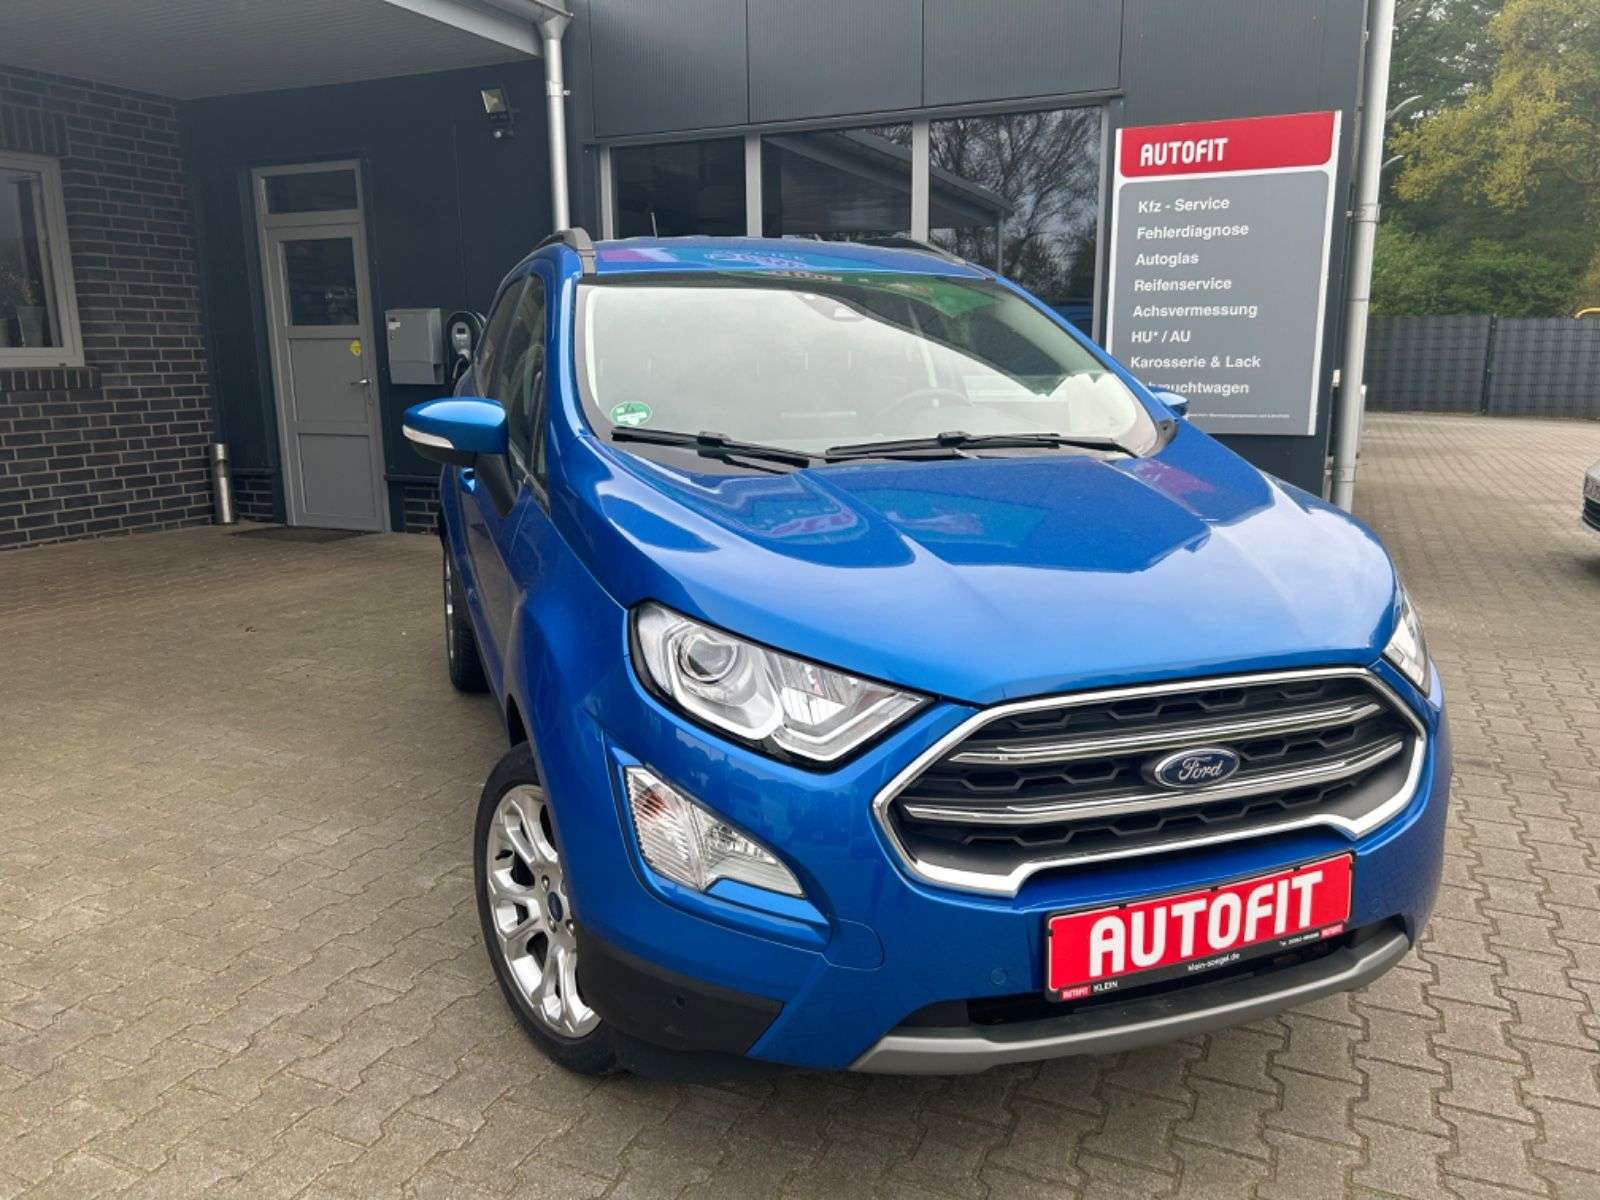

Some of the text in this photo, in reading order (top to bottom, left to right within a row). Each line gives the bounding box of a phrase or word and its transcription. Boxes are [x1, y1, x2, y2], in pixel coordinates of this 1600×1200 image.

[1140, 137, 1229, 167] AUTOFIT
[1138, 199, 1162, 214] Kfz
[1174, 197, 1230, 212] Service
[1137, 223, 1249, 240] Fehlerdiagnose
[1135, 253, 1200, 267] Autoglas
[1134, 278, 1232, 292] Reifenservice
[1132, 304, 1258, 318] Achsvermessung
[1170, 330, 1191, 342] AU
[1130, 355, 1262, 368] Karosserie & Lack
[1148, 381, 1250, 396] uchtwagen
[1178, 757, 1225, 780] Ford
[1089, 870, 1323, 978] AUTOFIT
